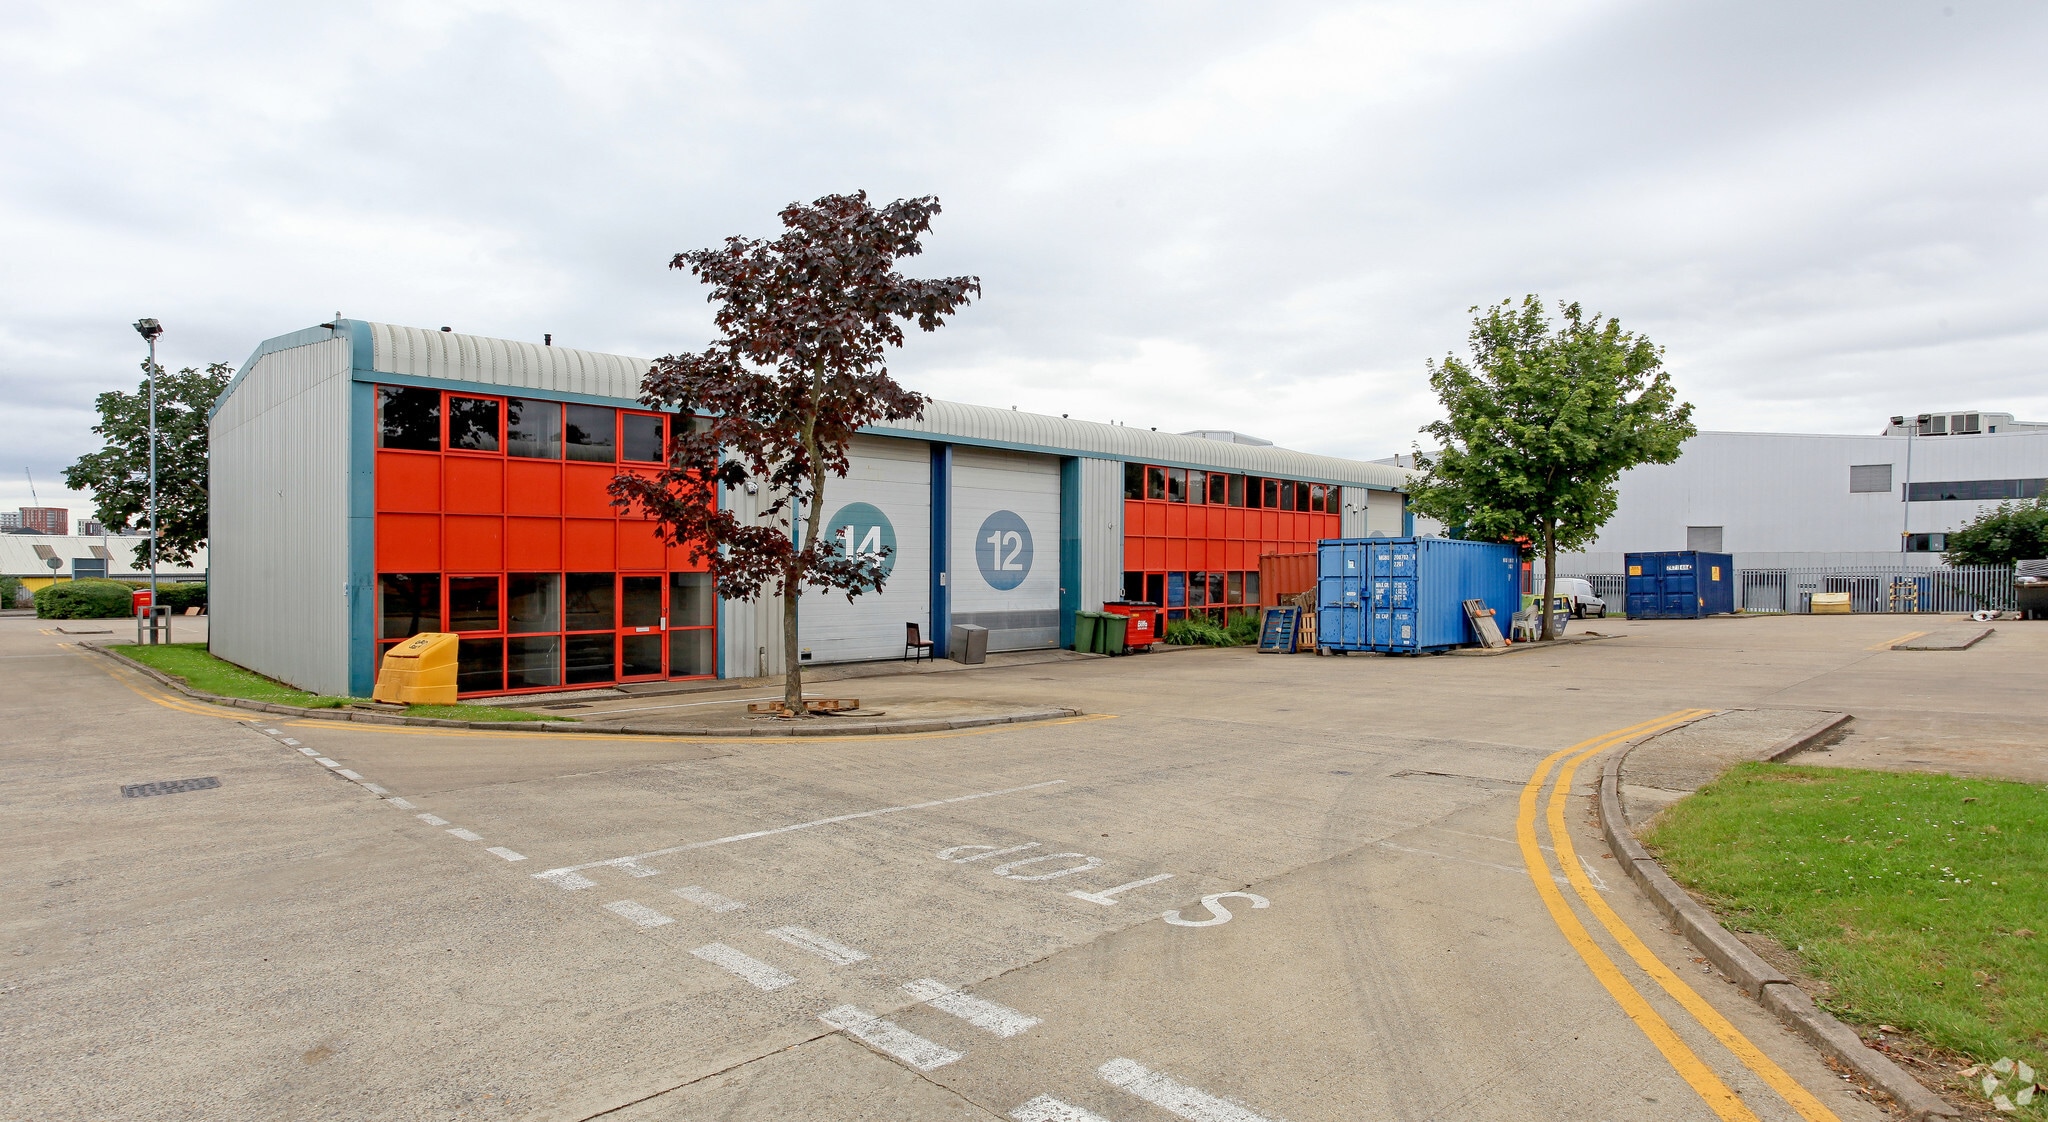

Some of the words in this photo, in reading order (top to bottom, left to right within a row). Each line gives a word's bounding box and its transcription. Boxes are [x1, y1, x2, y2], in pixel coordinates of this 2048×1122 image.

[836, 525, 885, 569] 14
[987, 530, 1023, 571] 12
[936, 841, 1270, 927] STOP
